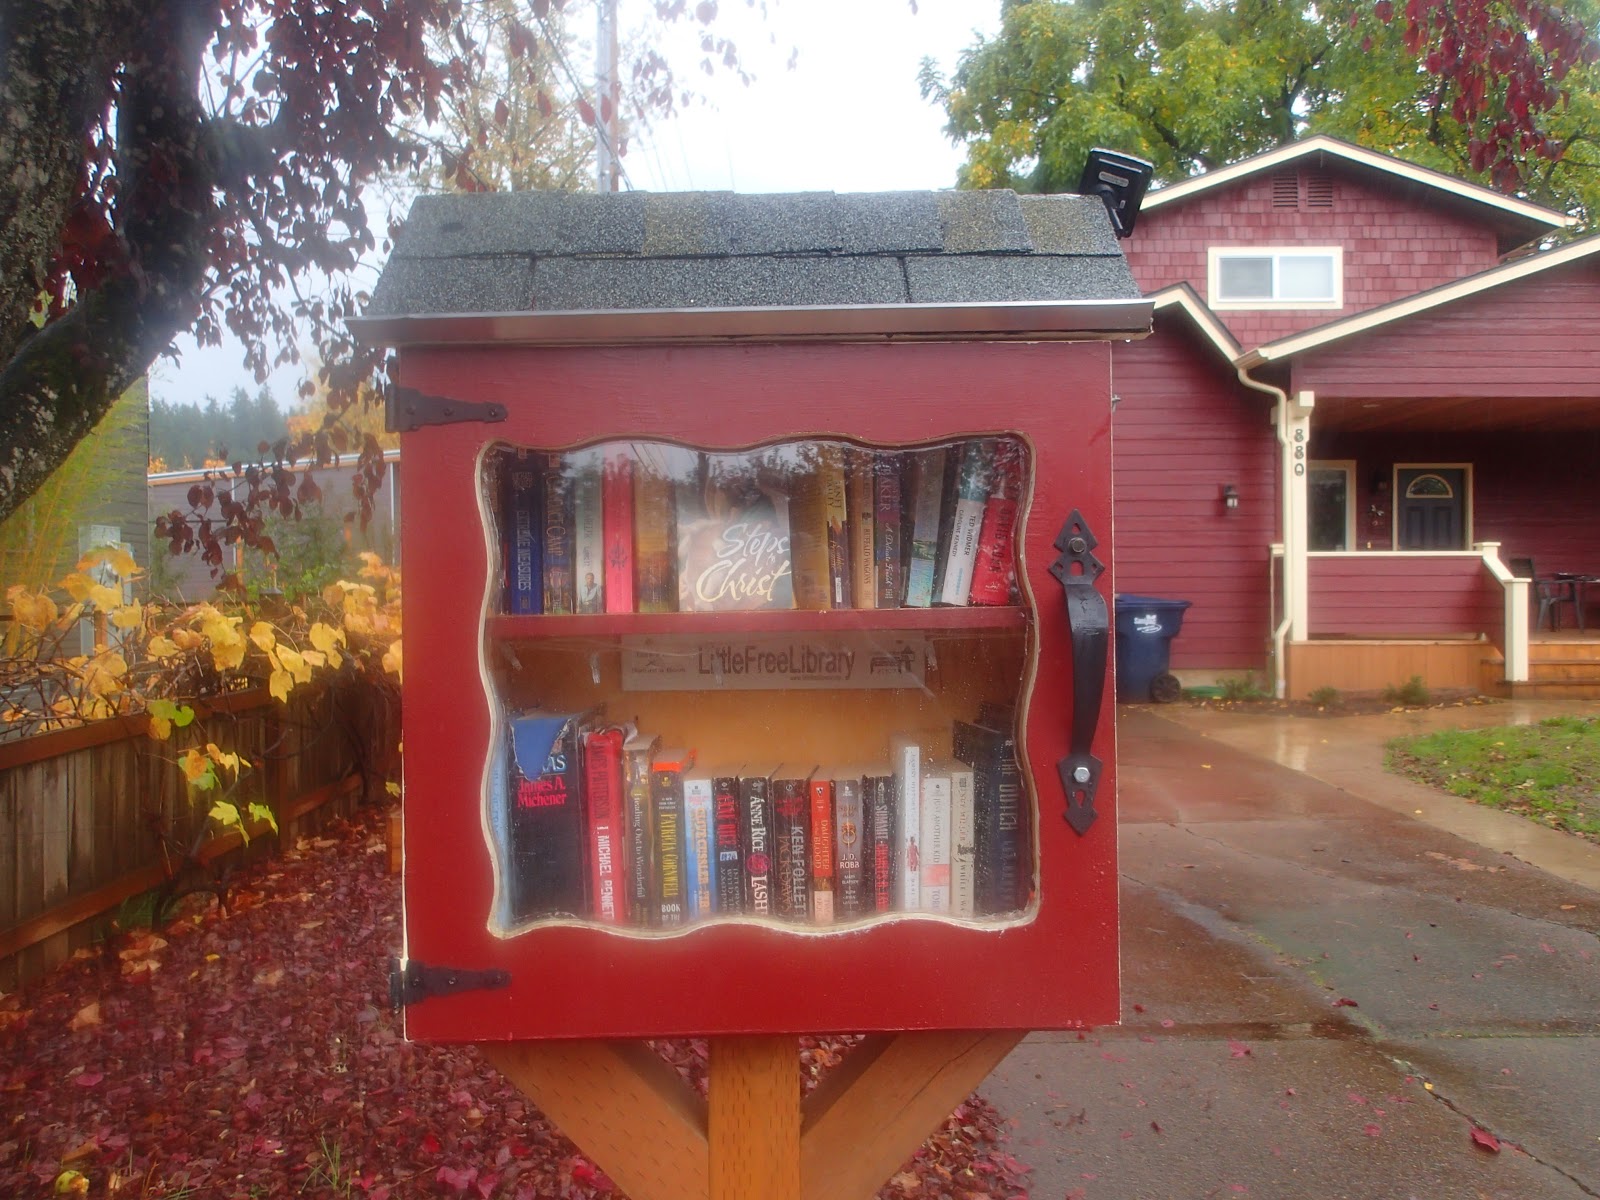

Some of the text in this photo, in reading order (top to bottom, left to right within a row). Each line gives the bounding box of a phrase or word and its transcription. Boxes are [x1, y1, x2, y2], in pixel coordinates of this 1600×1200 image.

[517, 511, 530, 547] EXTREME
[956, 510, 964, 533] CAROLINE
[546, 526, 566, 556] CAMP
[717, 523, 790, 566] Steps
[518, 548, 531, 591] MEASURES
[696, 558, 791, 602] Christ
[699, 645, 856, 680] LittleFreeLibrary
[543, 754, 567, 772] AS
[517, 793, 567, 808] Michener
[518, 775, 567, 792] James A.
[592, 771, 609, 819] PATTERSON
[633, 793, 642, 828] Heading
[750, 796, 766, 853] ANNE RICE
[875, 805, 888, 840] SUMMIT
[635, 829, 643, 844] Out
[660, 813, 677, 852] PATRICIA
[791, 826, 804, 855] KEN
[821, 819, 829, 870] DAUGHTER
[598, 835, 612, 876] MICHAEL
[636, 846, 642, 855] to
[839, 861, 860, 869] ROBB
[636, 857, 645, 898] Wonderful
[662, 854, 679, 897] CORNWELL
[661, 903, 681, 913] BOOK
